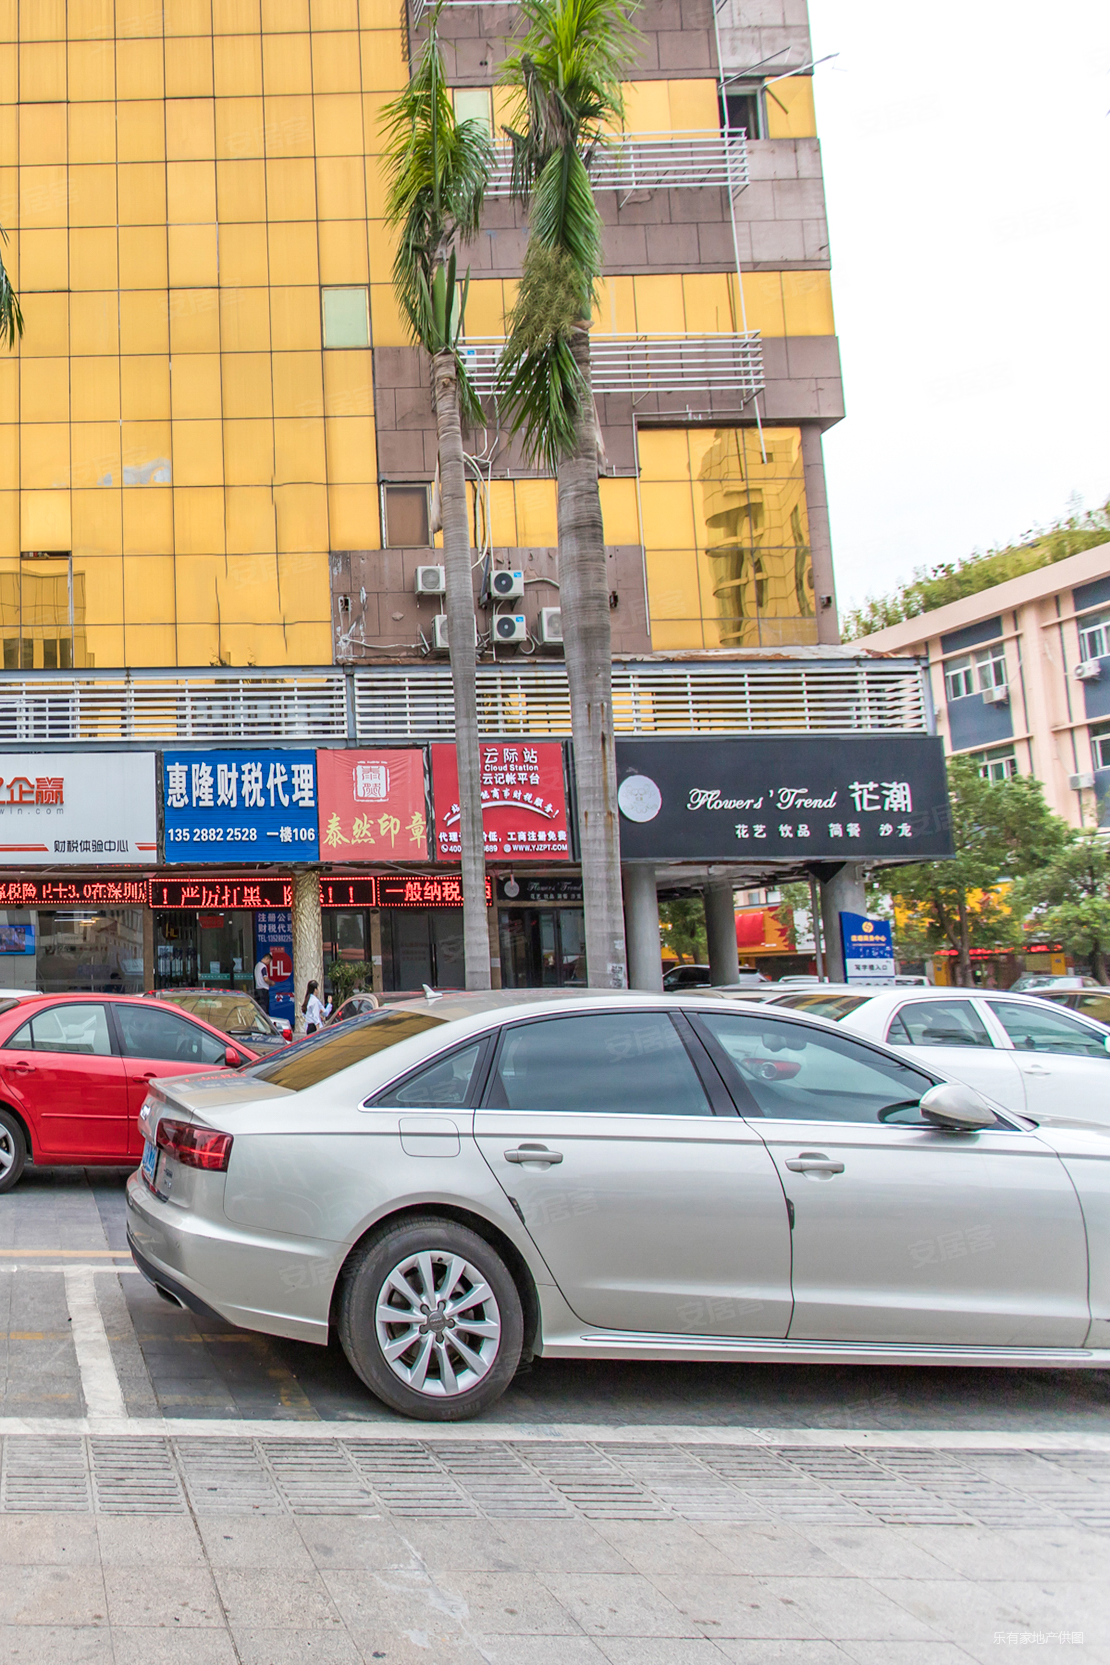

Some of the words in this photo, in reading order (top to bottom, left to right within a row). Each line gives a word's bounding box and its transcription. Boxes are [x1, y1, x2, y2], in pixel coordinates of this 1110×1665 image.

[483, 747, 538, 763] 云际站
[484, 764, 508, 772] Cloud
[509, 764, 539, 772] Station
[167, 762, 316, 808] 惠隆财税代理
[480, 773, 540, 785] 云记帐平台
[775, 786, 837, 810] Trend
[847, 780, 913, 813] 花潮
[168, 828, 190, 842] 135
[193, 828, 224, 842] 2882
[226, 828, 258, 842] 2528
[267, 826, 316, 843] 一楼106
[323, 811, 427, 849] 泰然印章
[439, 832, 461, 842] 代理
[734, 824, 766, 838] 花艺
[779, 823, 810, 838] 饮品
[828, 823, 861, 838] 简餐
[879, 823, 912, 838] 沙龙
[54, 840, 129, 852] 财税体验中心
[386, 881, 465, 902] 一般纳税
[270, 960, 291, 977] HL
